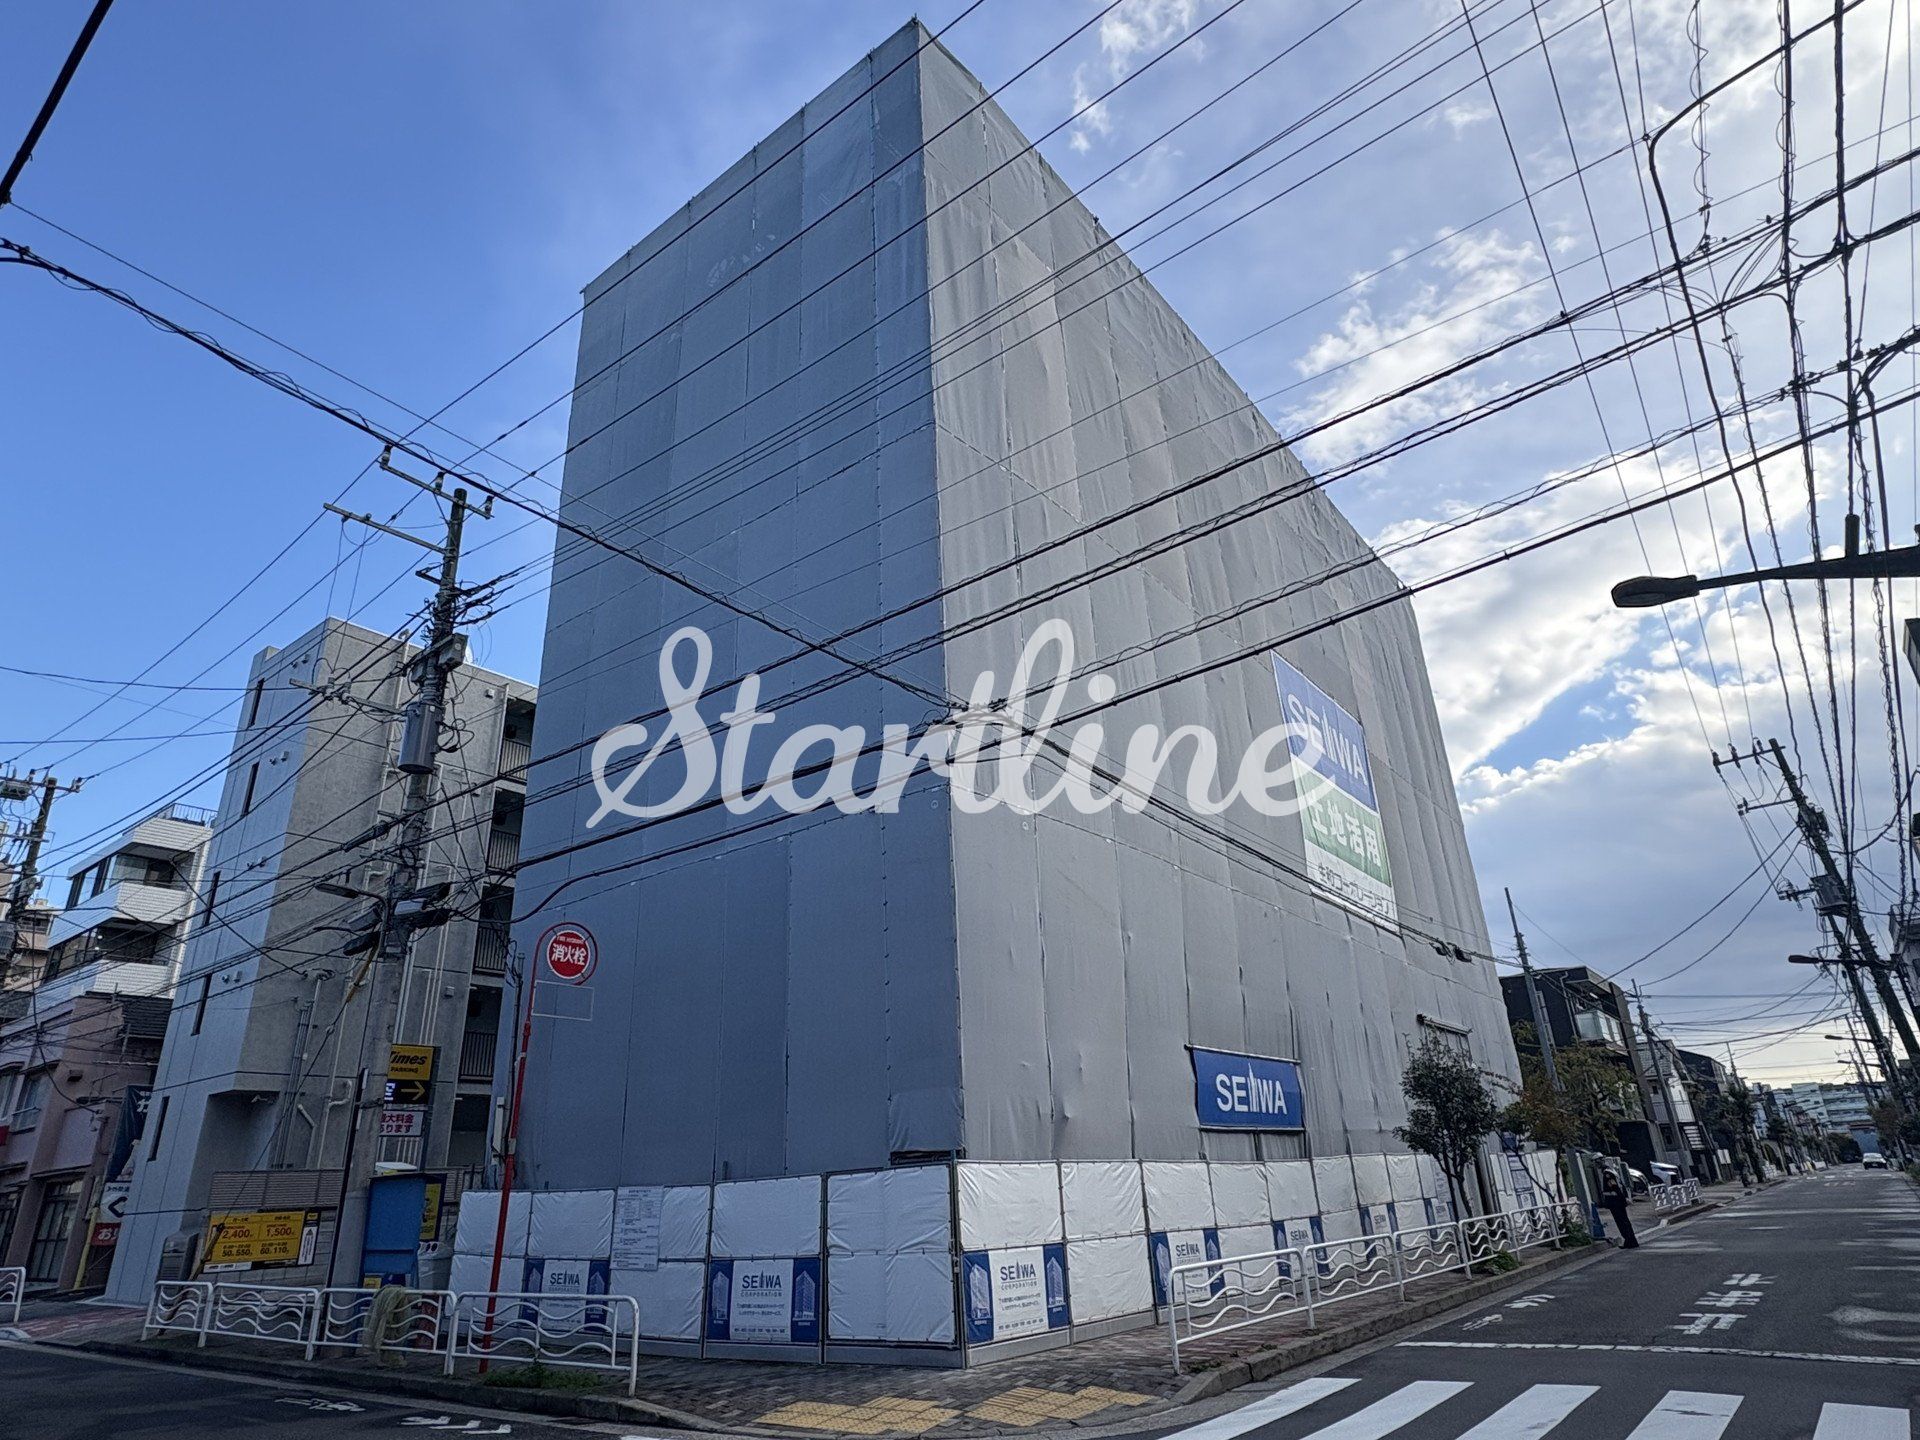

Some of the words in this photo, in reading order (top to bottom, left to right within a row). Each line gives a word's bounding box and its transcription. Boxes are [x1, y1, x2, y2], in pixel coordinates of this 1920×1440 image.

[1287, 693, 1369, 786] SEIWA
[1308, 789, 1382, 868] 土地活用
[551, 943, 587, 966] 消火栓
[390, 1051, 427, 1066] Times
[390, 1066, 419, 1074] PARKING
[1215, 1062, 1288, 1115] SEIWA
[1175, 1241, 1200, 1257] SEIWA
[549, 1270, 580, 1286] SEIWA
[742, 1269, 782, 1289] SEIWA
[1000, 1259, 1037, 1281] SEIWA
[1001, 1280, 1038, 1291] CORPORATION
